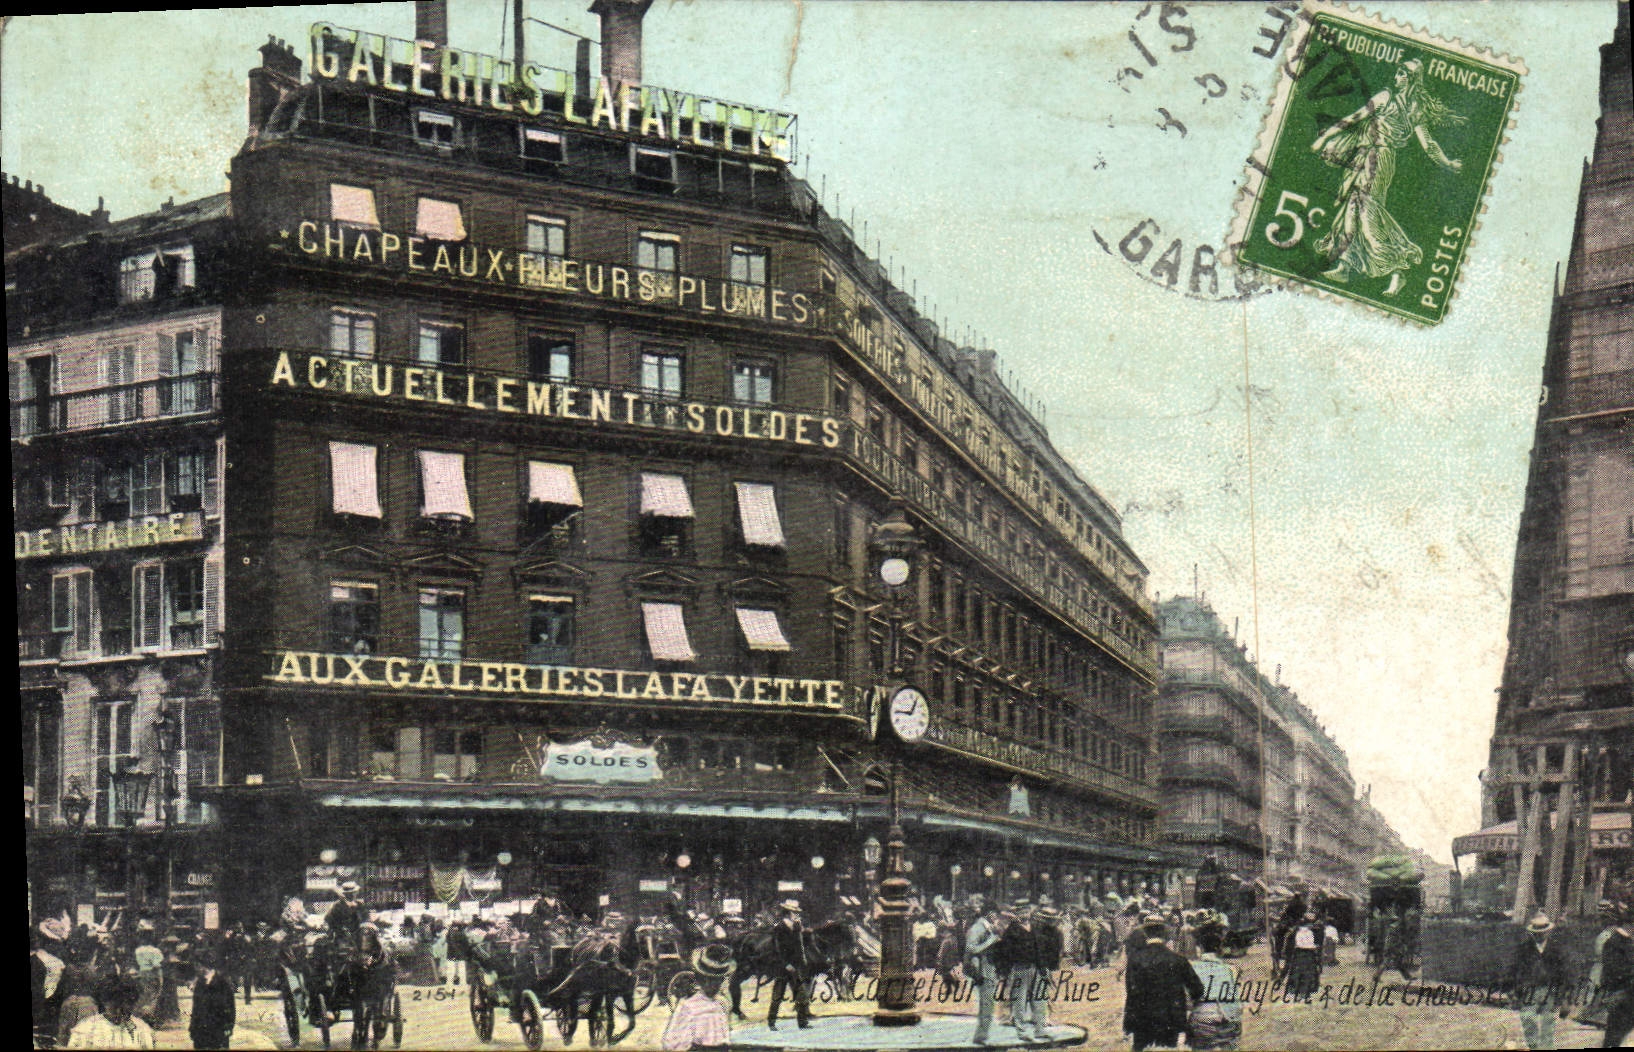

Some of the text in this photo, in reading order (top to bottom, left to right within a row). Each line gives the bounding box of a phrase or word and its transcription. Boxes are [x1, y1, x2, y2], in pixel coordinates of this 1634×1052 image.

[311, 22, 790, 163] GALERIES LAFAYETTE
[1427, 58, 1509, 99] FRANÇAISE
[299, 221, 808, 324] CHAPEAUX FLEURS PLUMES
[1421, 225, 1462, 309] POSTES
[271, 351, 840, 448] ACTUELLEMENT SOLDES
[15, 512, 187, 559] DENTAIRE
[274, 651, 369, 686] AUX
[384, 656, 604, 697] GALERIES
[615, 672, 845, 709] LAFAYETTE
[555, 754, 648, 769] SOLDES
